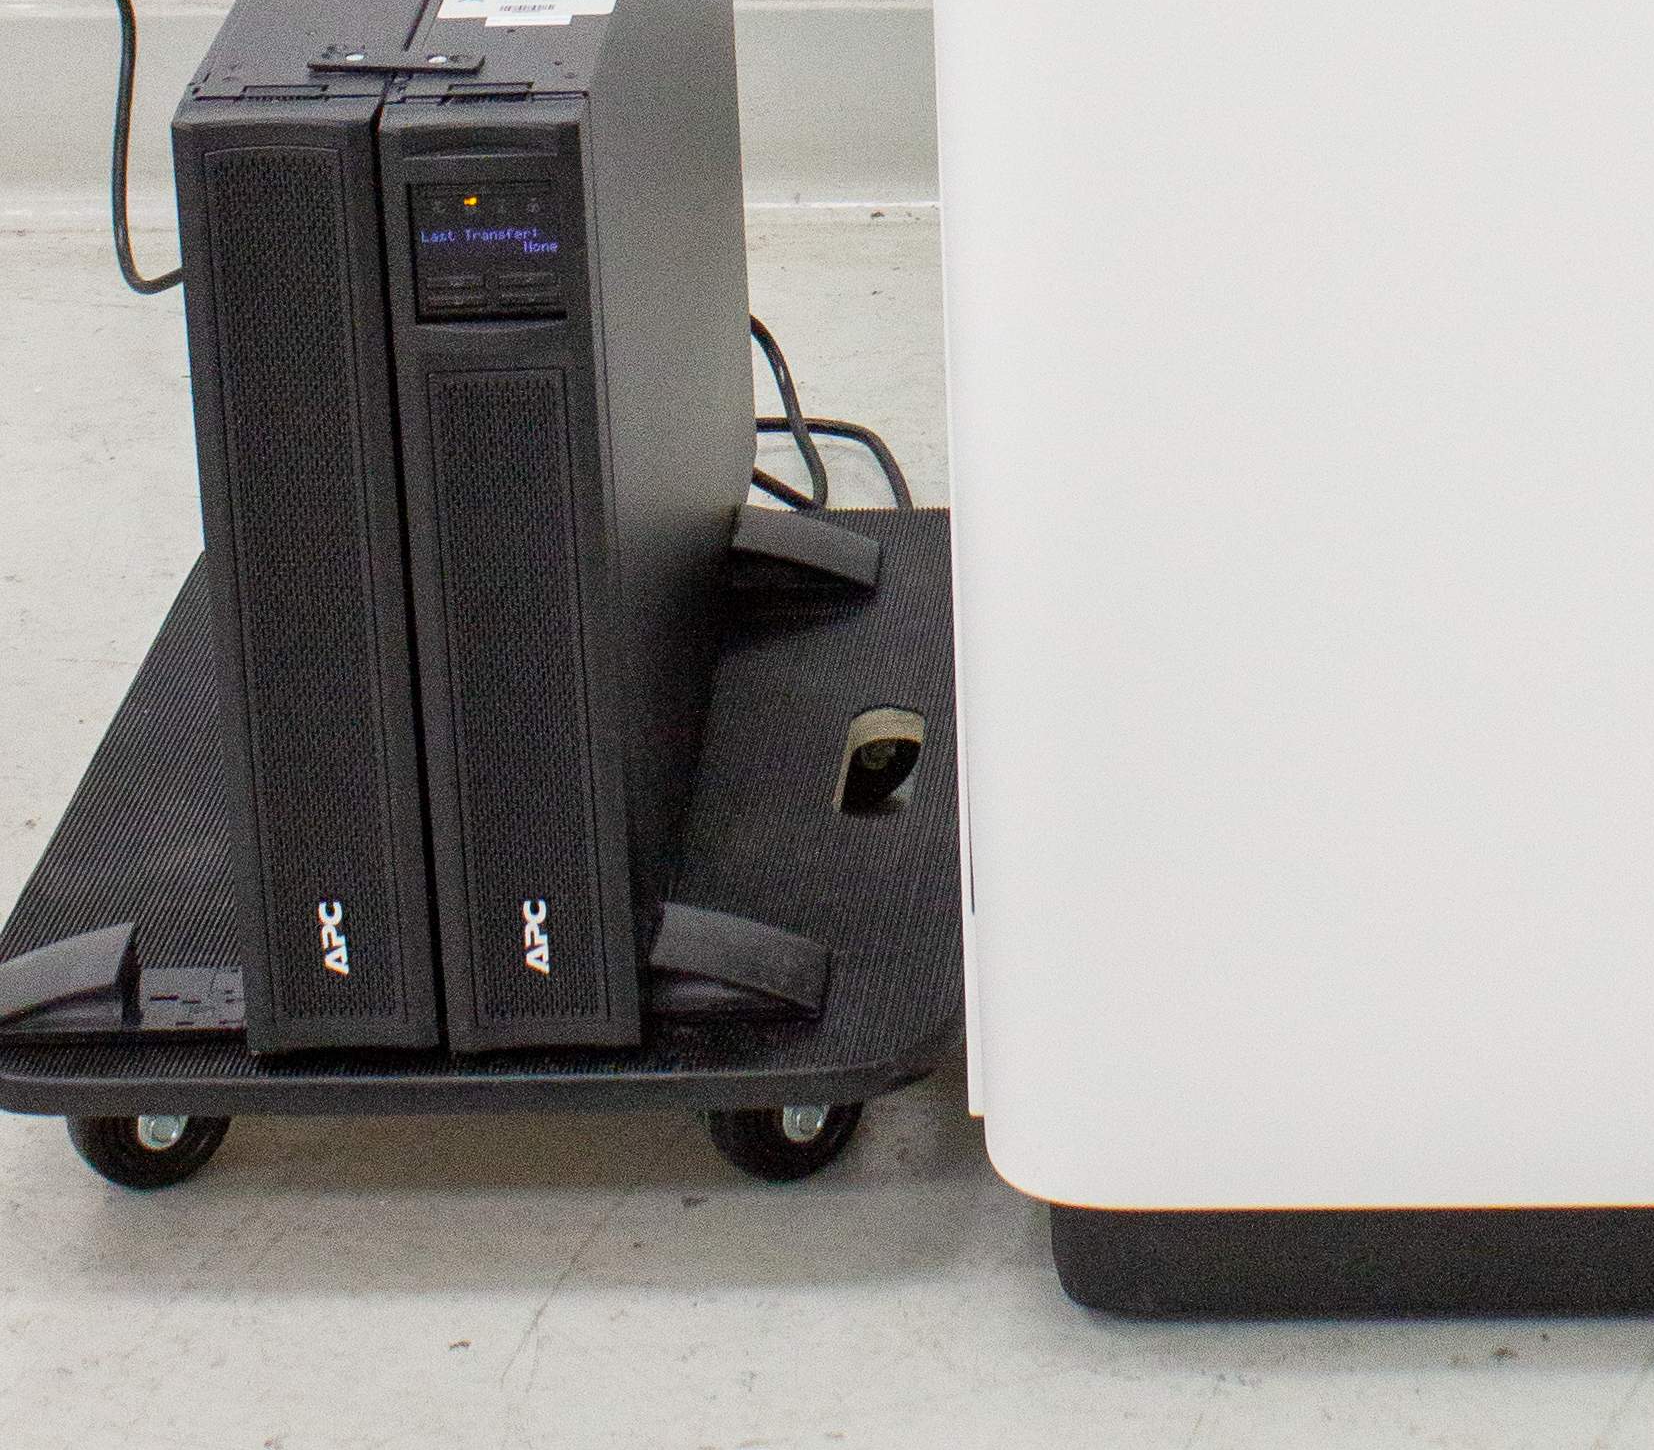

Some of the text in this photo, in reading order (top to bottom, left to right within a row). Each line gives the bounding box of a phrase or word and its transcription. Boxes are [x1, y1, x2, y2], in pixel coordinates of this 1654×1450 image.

[420, 229, 457, 244] Last
[523, 240, 559, 253] None
[318, 900, 350, 976] APC
[522, 899, 550, 975] APC
